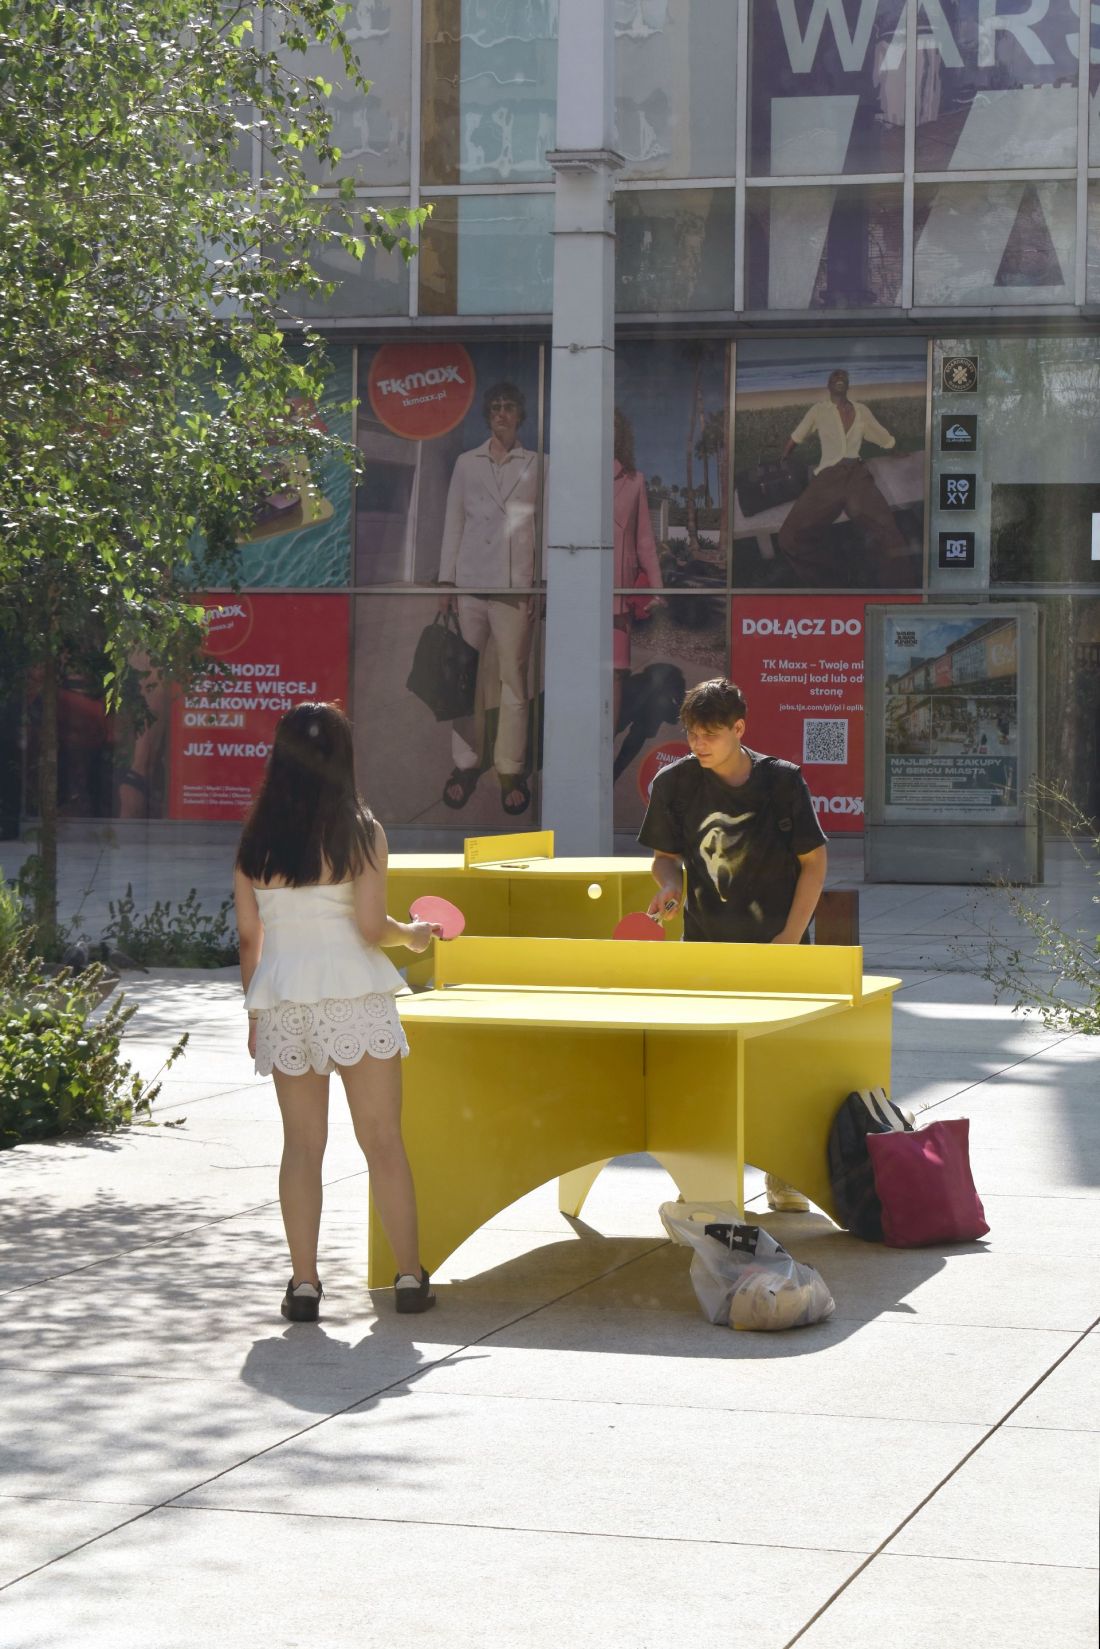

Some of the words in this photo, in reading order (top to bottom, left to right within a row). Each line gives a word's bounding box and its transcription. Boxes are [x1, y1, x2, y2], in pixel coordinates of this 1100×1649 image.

[742, 618, 826, 638] DOŁĄCZ
[830, 618, 862, 635] DO
[762, 660, 777, 669] TK
[779, 660, 807, 669] Maxx
[819, 660, 849, 671] Twoje
[761, 673, 807, 684] Zeskanuj
[809, 673, 829, 683] kod
[831, 674, 847, 683] lub
[850, 674, 864, 683] od
[255, 682, 317, 697] WIĘCEJ
[809, 687, 844, 697] stronę
[183, 740, 214, 756] JUŻ
[890, 758, 954, 766] NAJLEPSZE
[956, 758, 1002, 766] ZAKUPY
[892, 767, 903, 775] W
